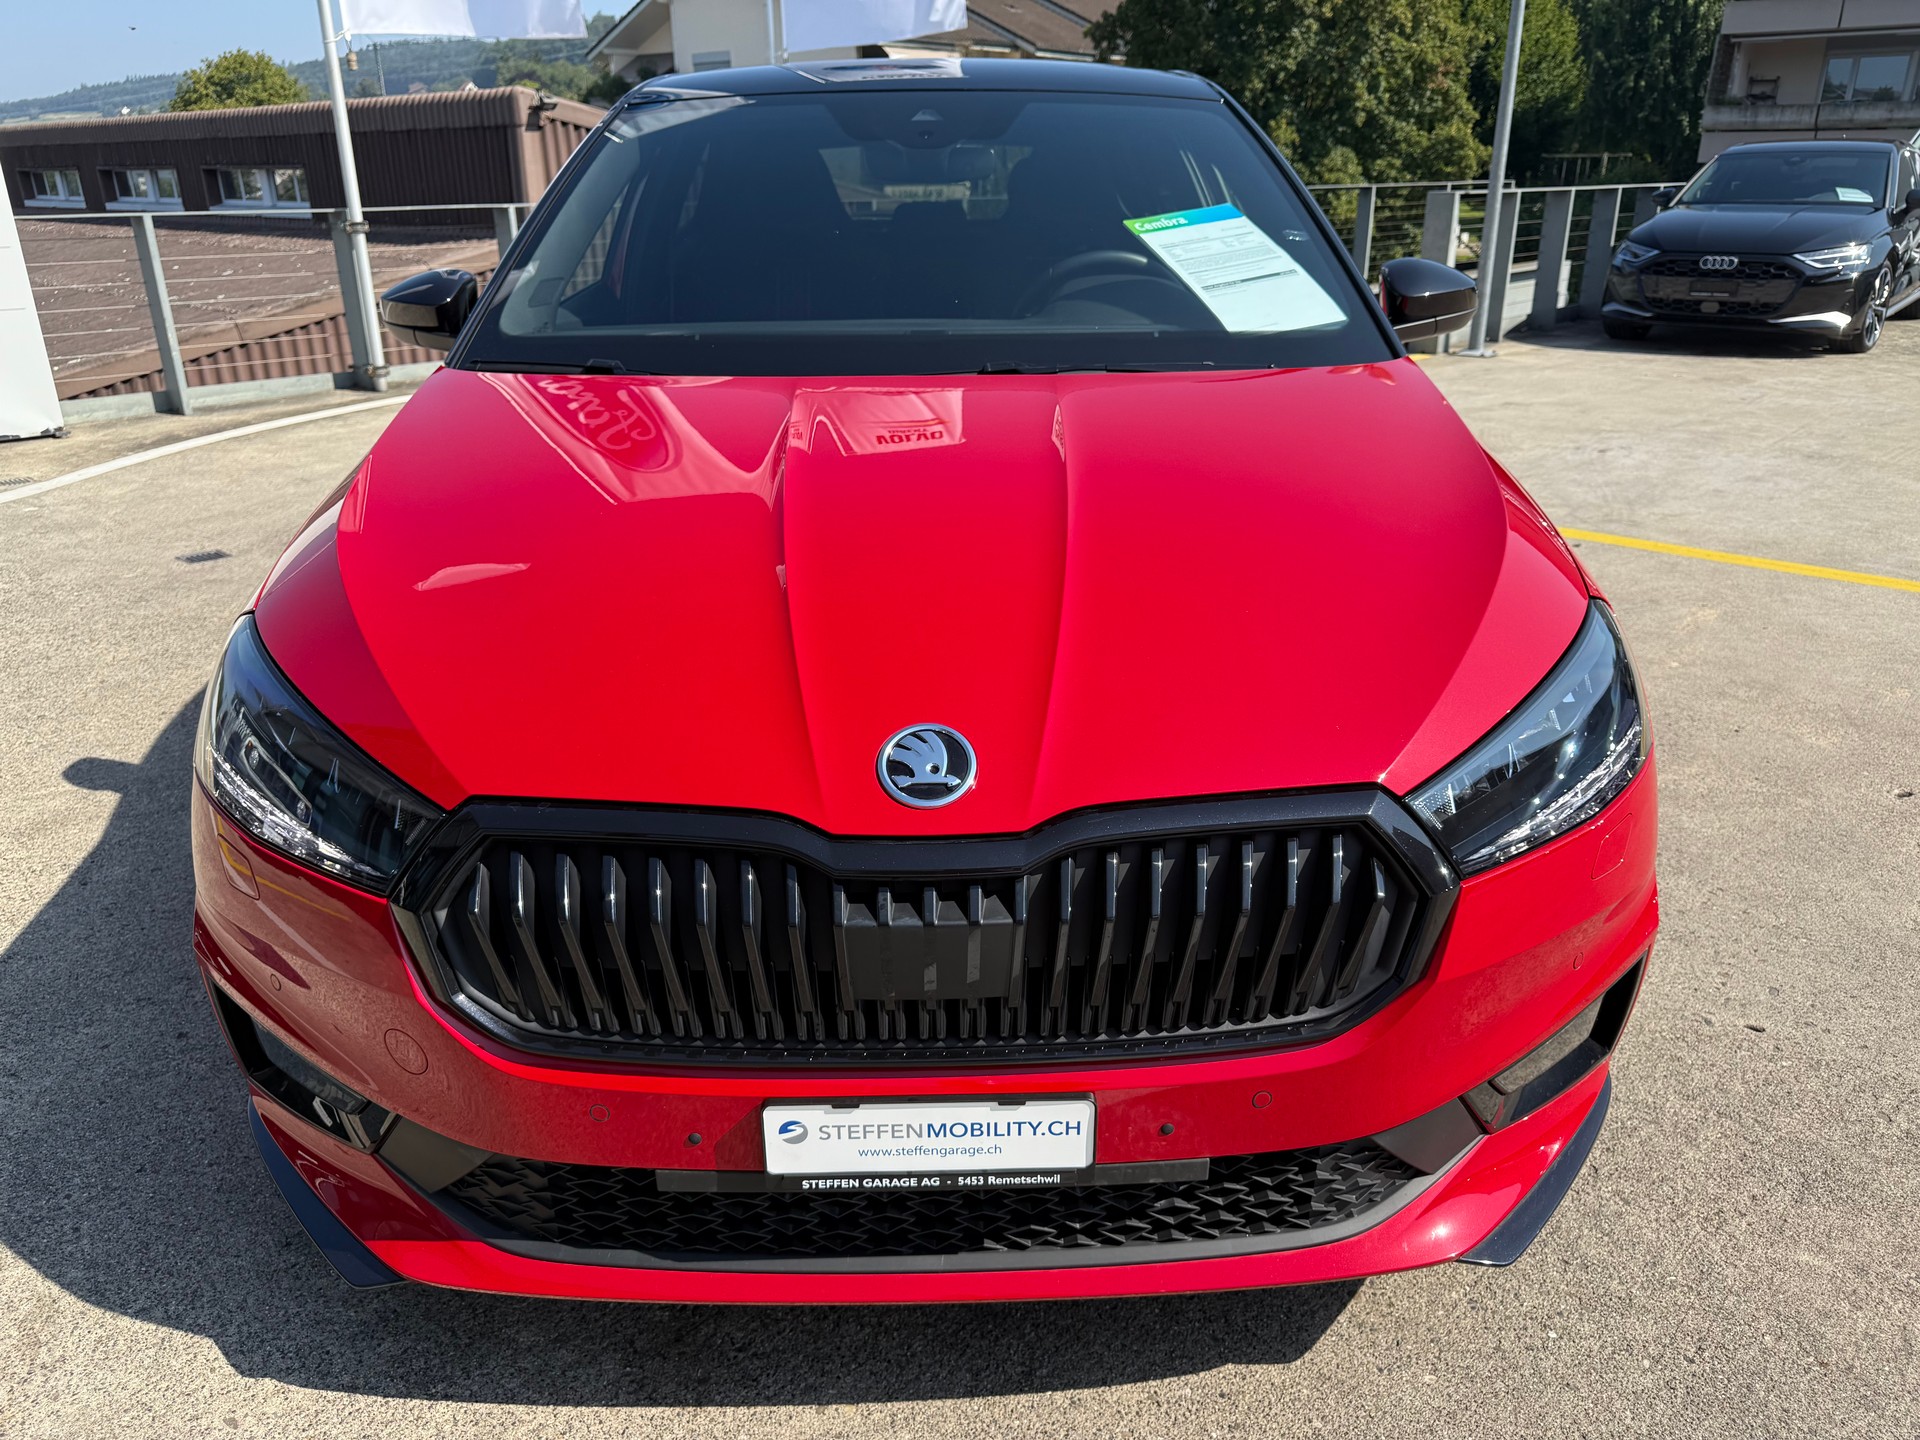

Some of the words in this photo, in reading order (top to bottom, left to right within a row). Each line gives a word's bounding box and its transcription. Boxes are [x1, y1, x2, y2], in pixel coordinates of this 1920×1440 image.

[1133, 217, 1188, 231] Cembra
[818, 1120, 1081, 1141] STEFFENMOBILITY.CH
[858, 1144, 1002, 1158] www.steffengarage.ch
[802, 1178, 860, 1190] STEFFEN
[863, 1177, 919, 1189] GARAGE
[921, 1176, 941, 1188] AG
[957, 1175, 984, 1187] 5453
[987, 1174, 1061, 1186] Remetschwil
